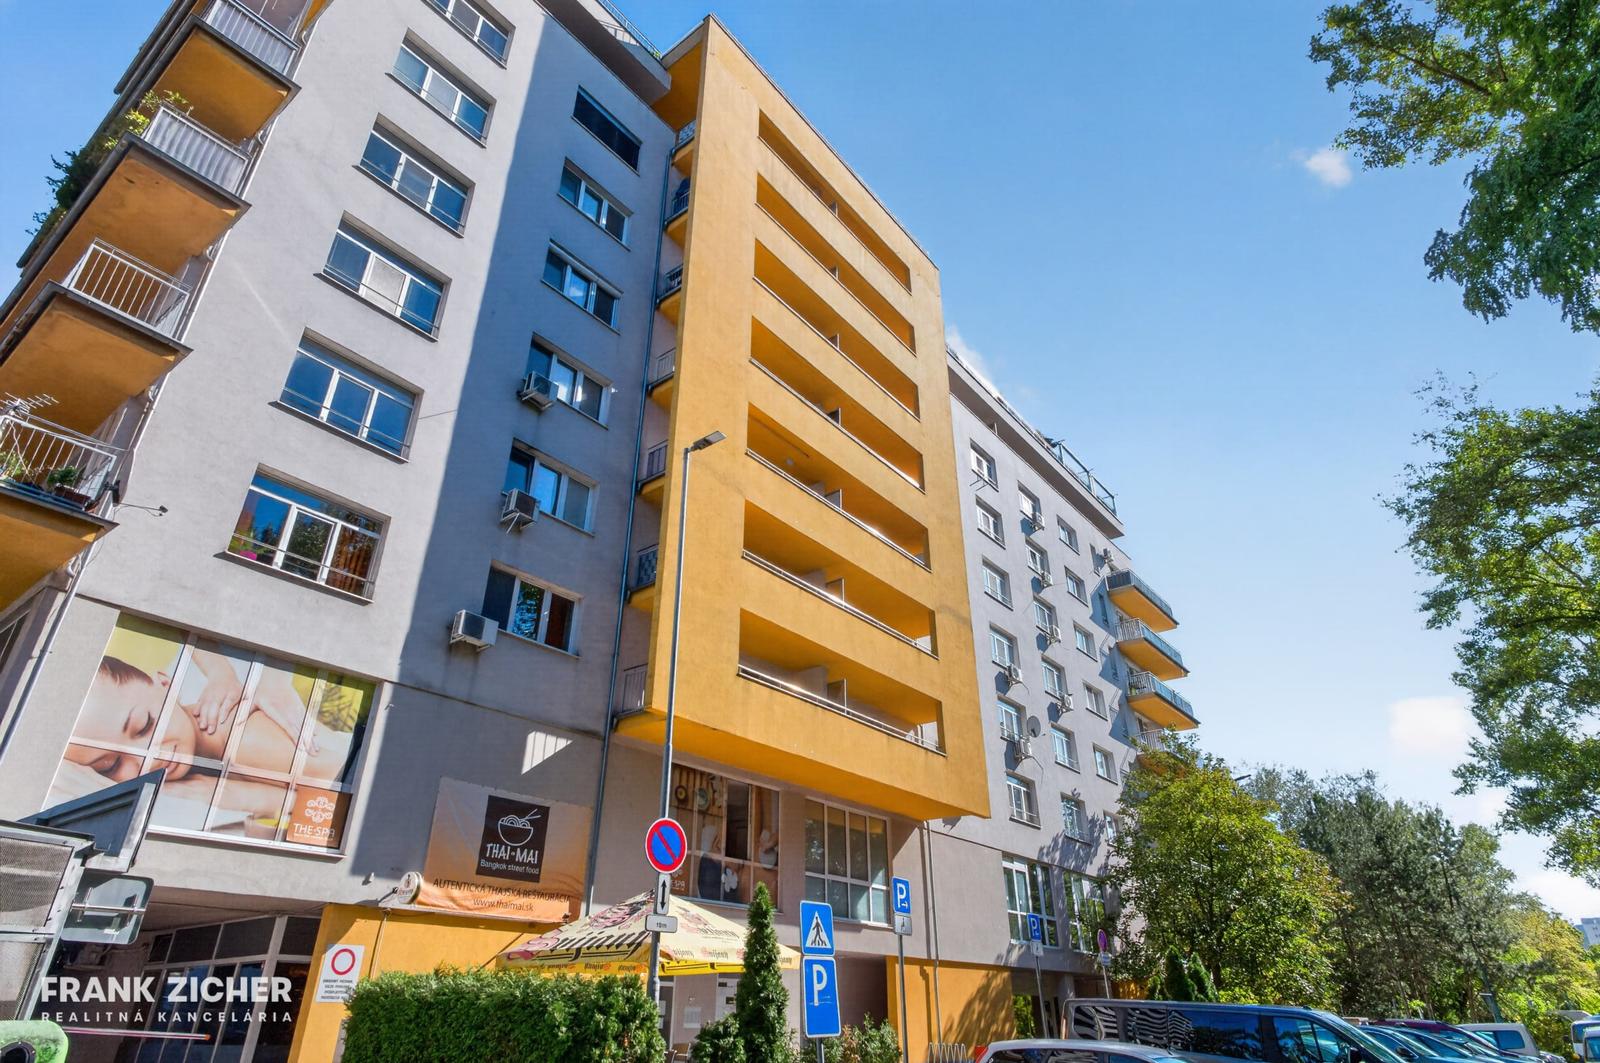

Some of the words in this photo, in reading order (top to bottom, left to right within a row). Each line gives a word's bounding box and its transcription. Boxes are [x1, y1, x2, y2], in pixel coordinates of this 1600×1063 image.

[293, 823, 313, 835] THE
[480, 859, 507, 871] Bangkok
[508, 864, 525, 873] street
[525, 866, 540, 875] food
[896, 882, 907, 908] P
[473, 898, 534, 912] www.thaimai.sk
[812, 964, 828, 1006] P
